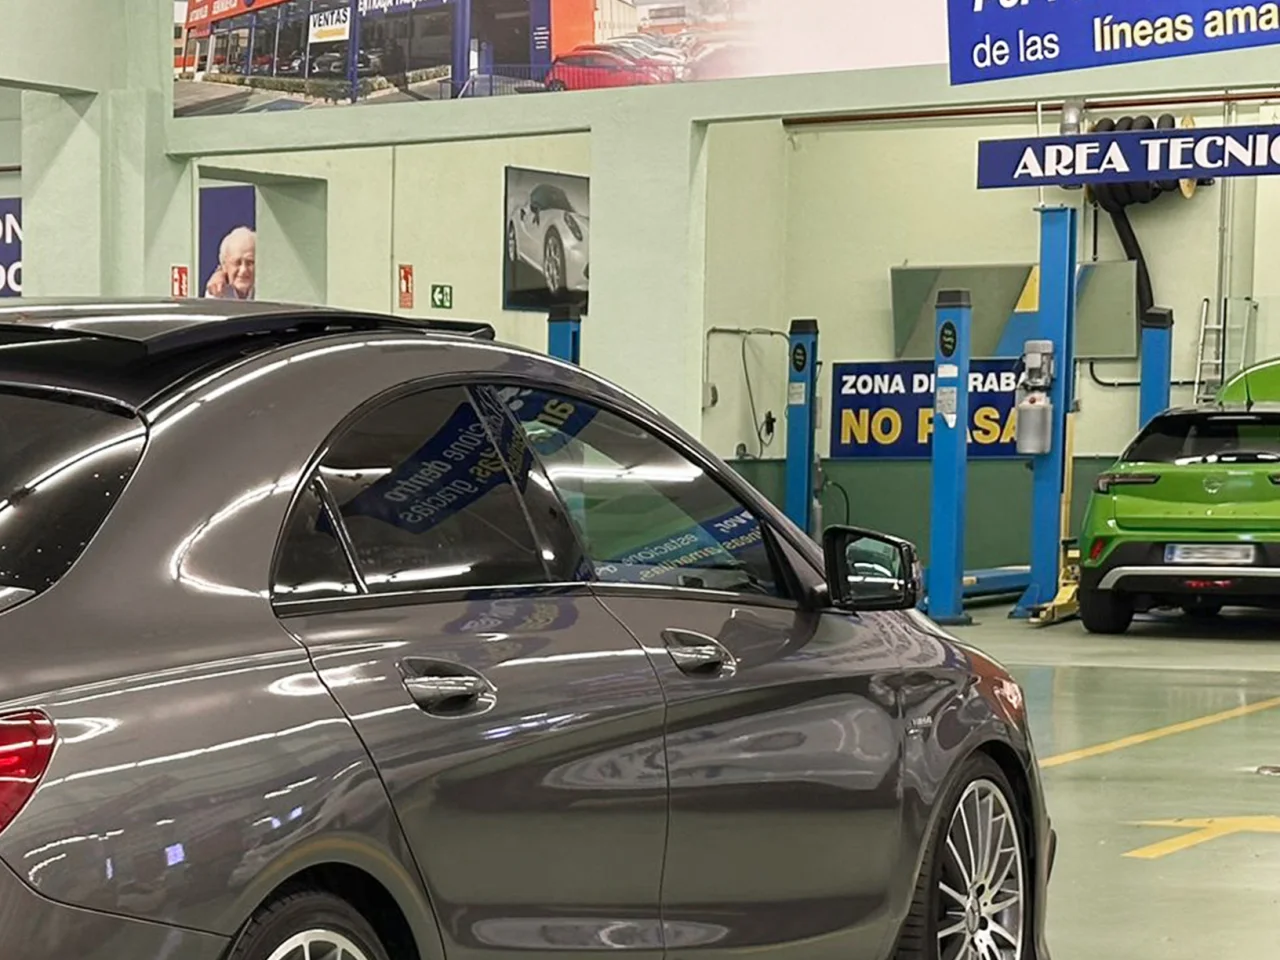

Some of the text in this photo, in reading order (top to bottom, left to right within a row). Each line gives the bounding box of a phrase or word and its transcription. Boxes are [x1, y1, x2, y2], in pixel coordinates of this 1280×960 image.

[312, 9, 348, 28] VENTAS
[973, 35, 1009, 68] de
[1019, 30, 1060, 62] las
[1093, 14, 1194, 52] líneas
[1013, 141, 1130, 179] AREA
[841, 374, 906, 395] ZONA
[968, 372, 1026, 394] RAB
[840, 406, 1018, 445] NO PSA
